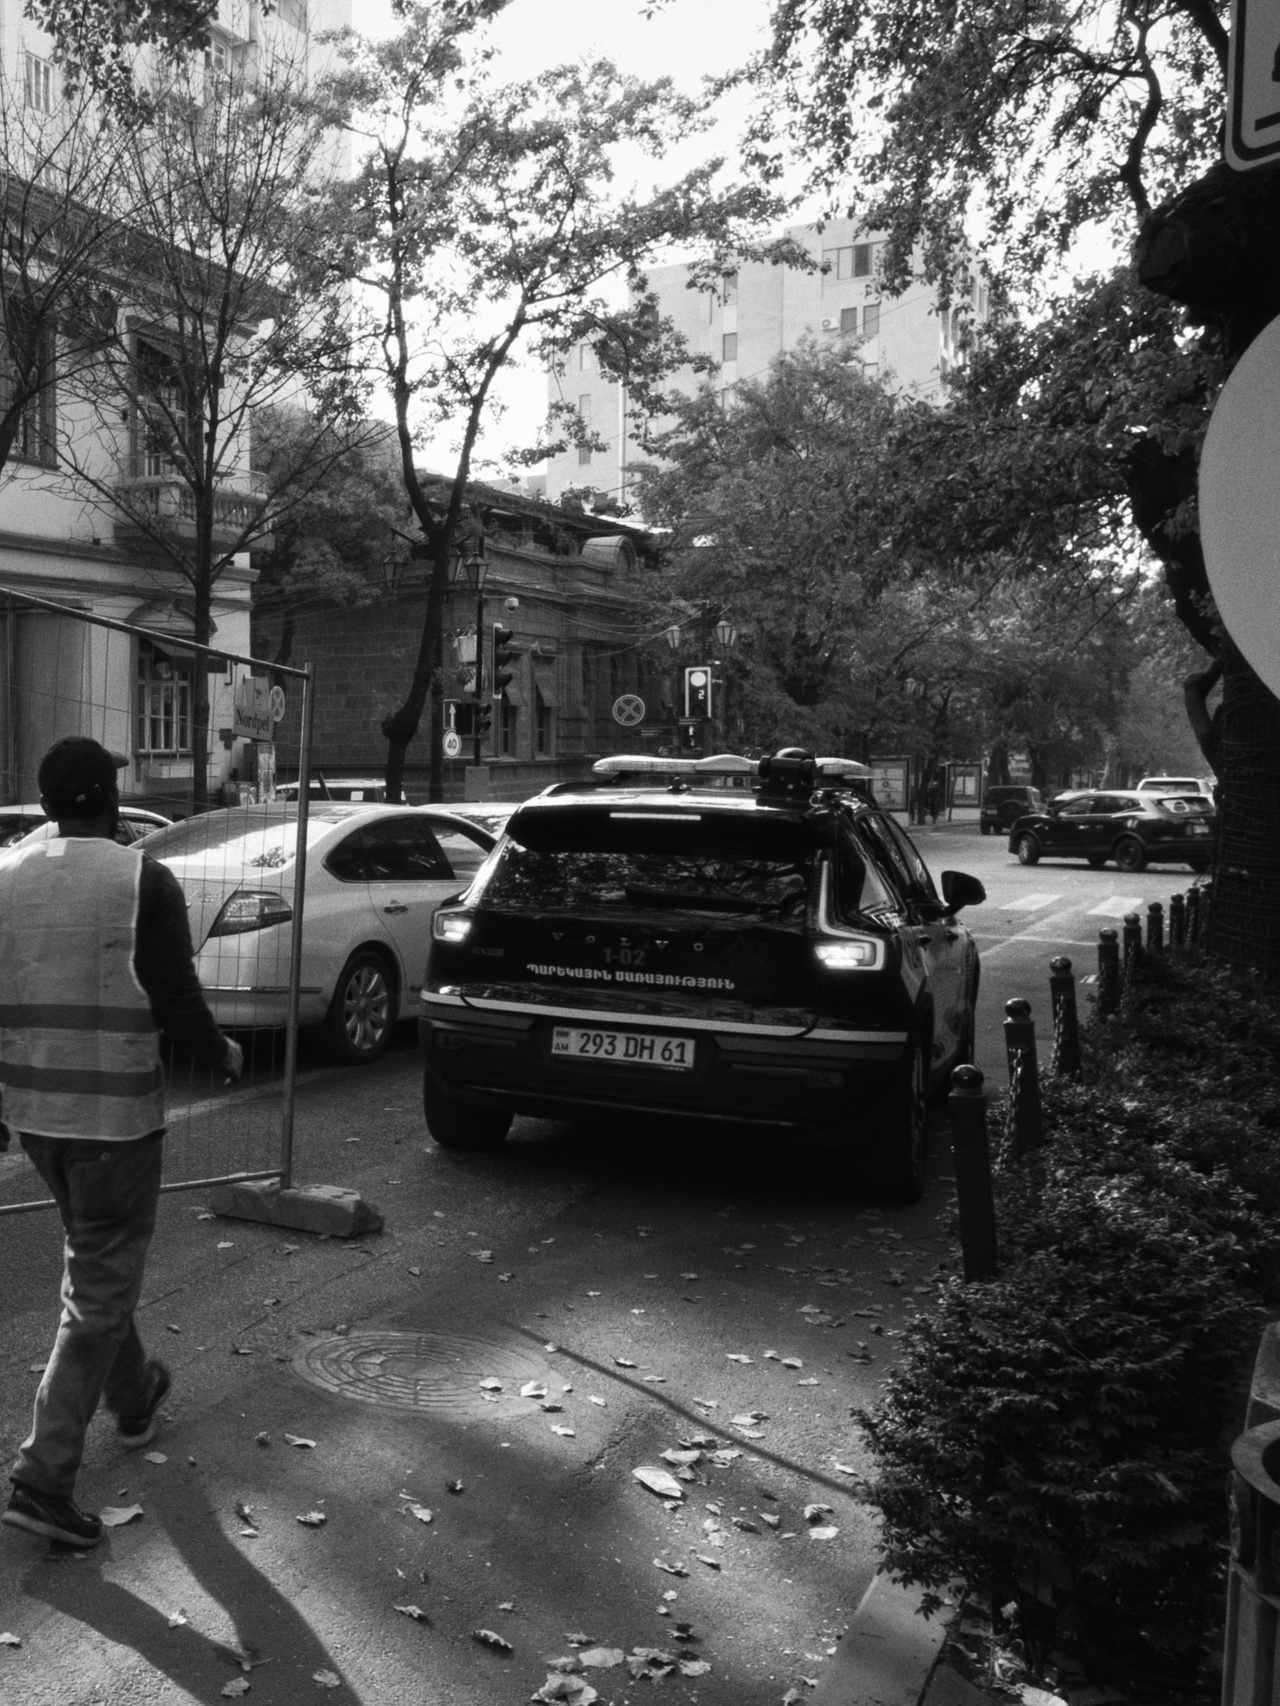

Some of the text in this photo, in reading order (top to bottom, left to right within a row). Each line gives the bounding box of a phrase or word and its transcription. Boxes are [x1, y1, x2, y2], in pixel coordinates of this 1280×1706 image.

[698, 689, 705, 700] 2
[235, 708, 270, 736] Nordpel
[447, 738, 457, 750] 40
[551, 932, 704, 951] VOLVO
[602, 947, 646, 966] 1-02
[526, 963, 735, 990] ՊԱՐԵԿԱՅԻՆ ԾԱՌԱՅՈՒԹՅՈՒՆ
[554, 1042, 569, 1051] AM
[579, 1032, 687, 1065] 293 DH 61
